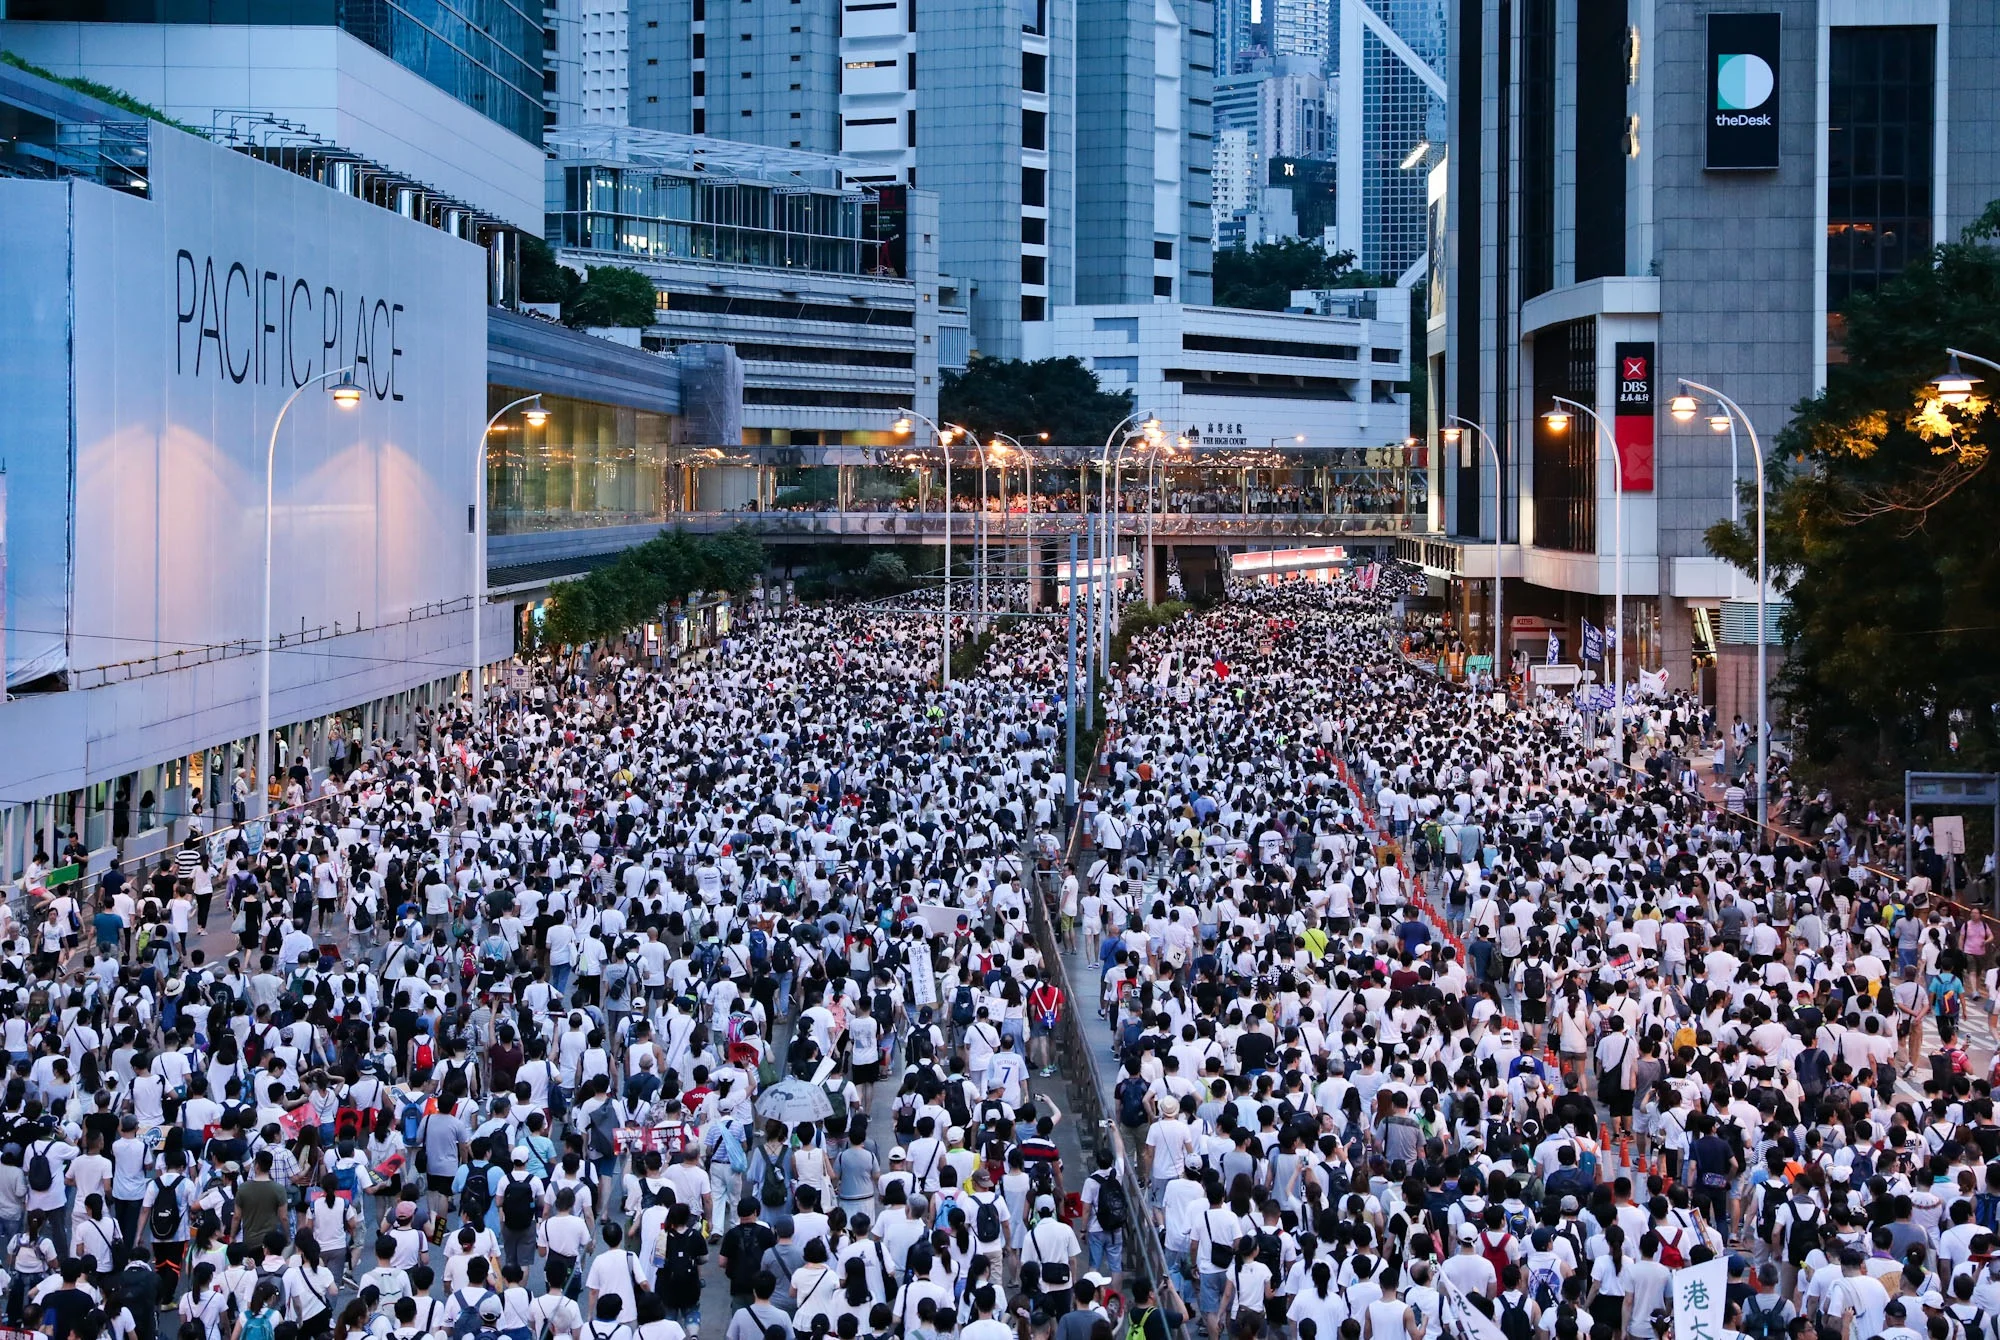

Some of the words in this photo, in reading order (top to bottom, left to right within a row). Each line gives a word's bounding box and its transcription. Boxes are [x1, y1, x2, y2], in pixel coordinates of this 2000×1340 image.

[1715, 114, 1771, 126] theDesk
[177, 249, 311, 389] PACIFIC
[322, 286, 404, 401] PLACE
[1622, 381, 1647, 393] DBS
[1207, 422, 1242, 434] 高等法院
[1203, 437, 1213, 445] THE
[1214, 437, 1228, 445] HIGH
[1229, 437, 1247, 446] COURT
[1002, 1067, 1011, 1084] 7
[1683, 1278, 1713, 1340] 港大
